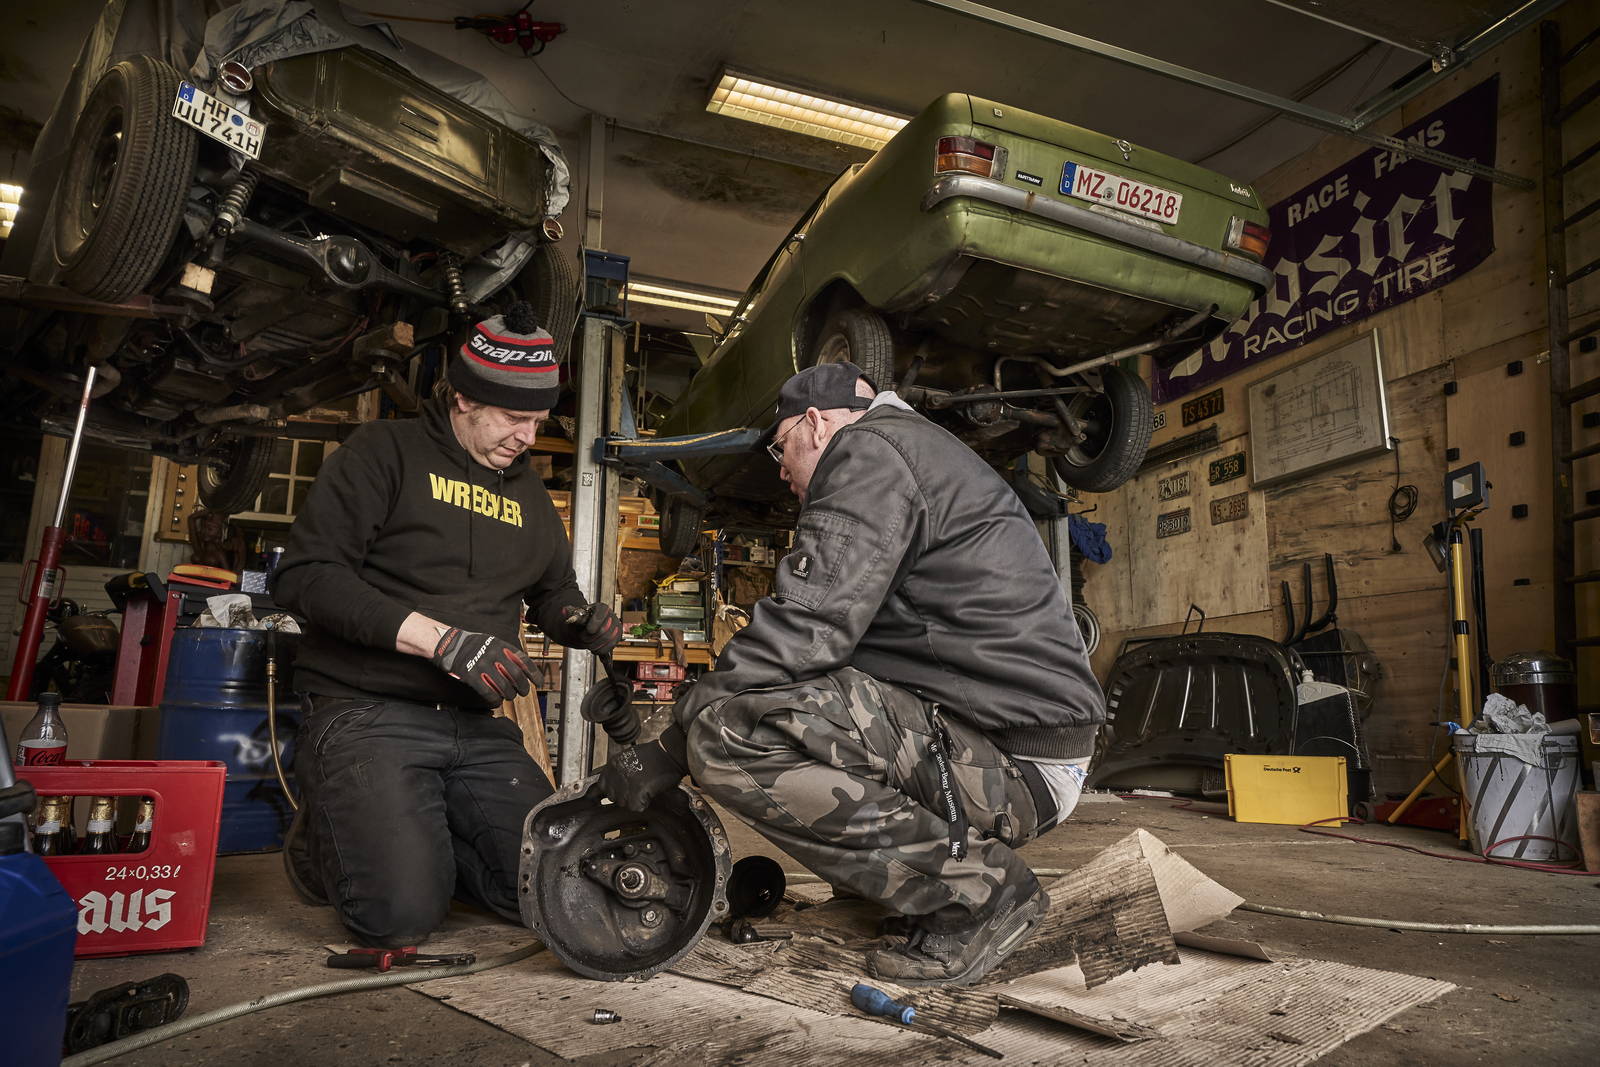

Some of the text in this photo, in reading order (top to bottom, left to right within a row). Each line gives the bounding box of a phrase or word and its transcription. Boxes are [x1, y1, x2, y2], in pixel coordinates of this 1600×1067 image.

[203, 96, 230, 122] HH
[210, 117, 259, 155] 741H
[1076, 169, 1106, 199] MZ
[1116, 181, 1177, 219] 06218
[1286, 119, 1447, 228] RACE FANS
[1168, 170, 1473, 380] osier
[1243, 244, 1456, 360] RACING TIRE
[944, 790, 957, 823] Museum
[76, 888, 177, 936] aus
